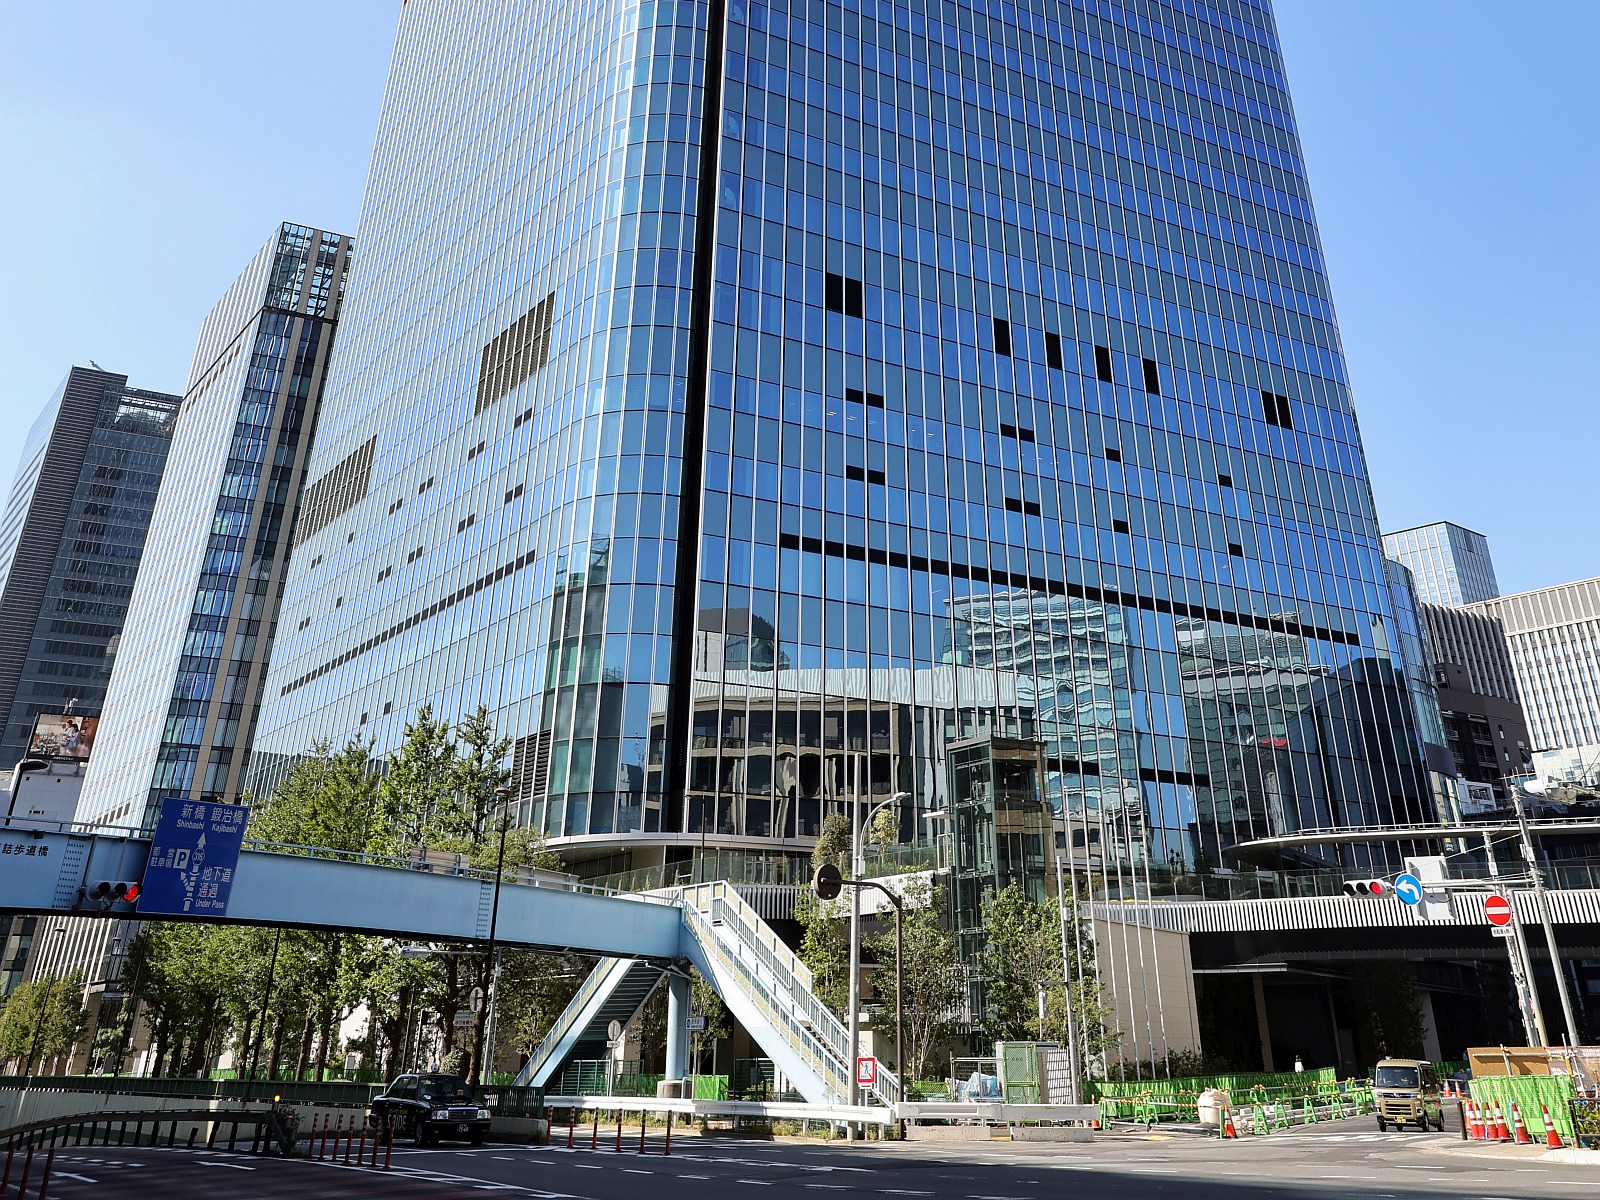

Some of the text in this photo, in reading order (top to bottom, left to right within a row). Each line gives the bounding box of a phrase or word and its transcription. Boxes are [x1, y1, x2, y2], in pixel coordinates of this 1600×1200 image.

[181, 803, 206, 820] 新橋
[177, 820, 205, 830] Shinbashi
[212, 824, 238, 834] Kajibashi
[0, 843, 49, 857] 詰歩道橋
[201, 866, 232, 883] 地下道
[198, 882, 219, 898] 通過
[196, 900, 225, 909] Under Pass
